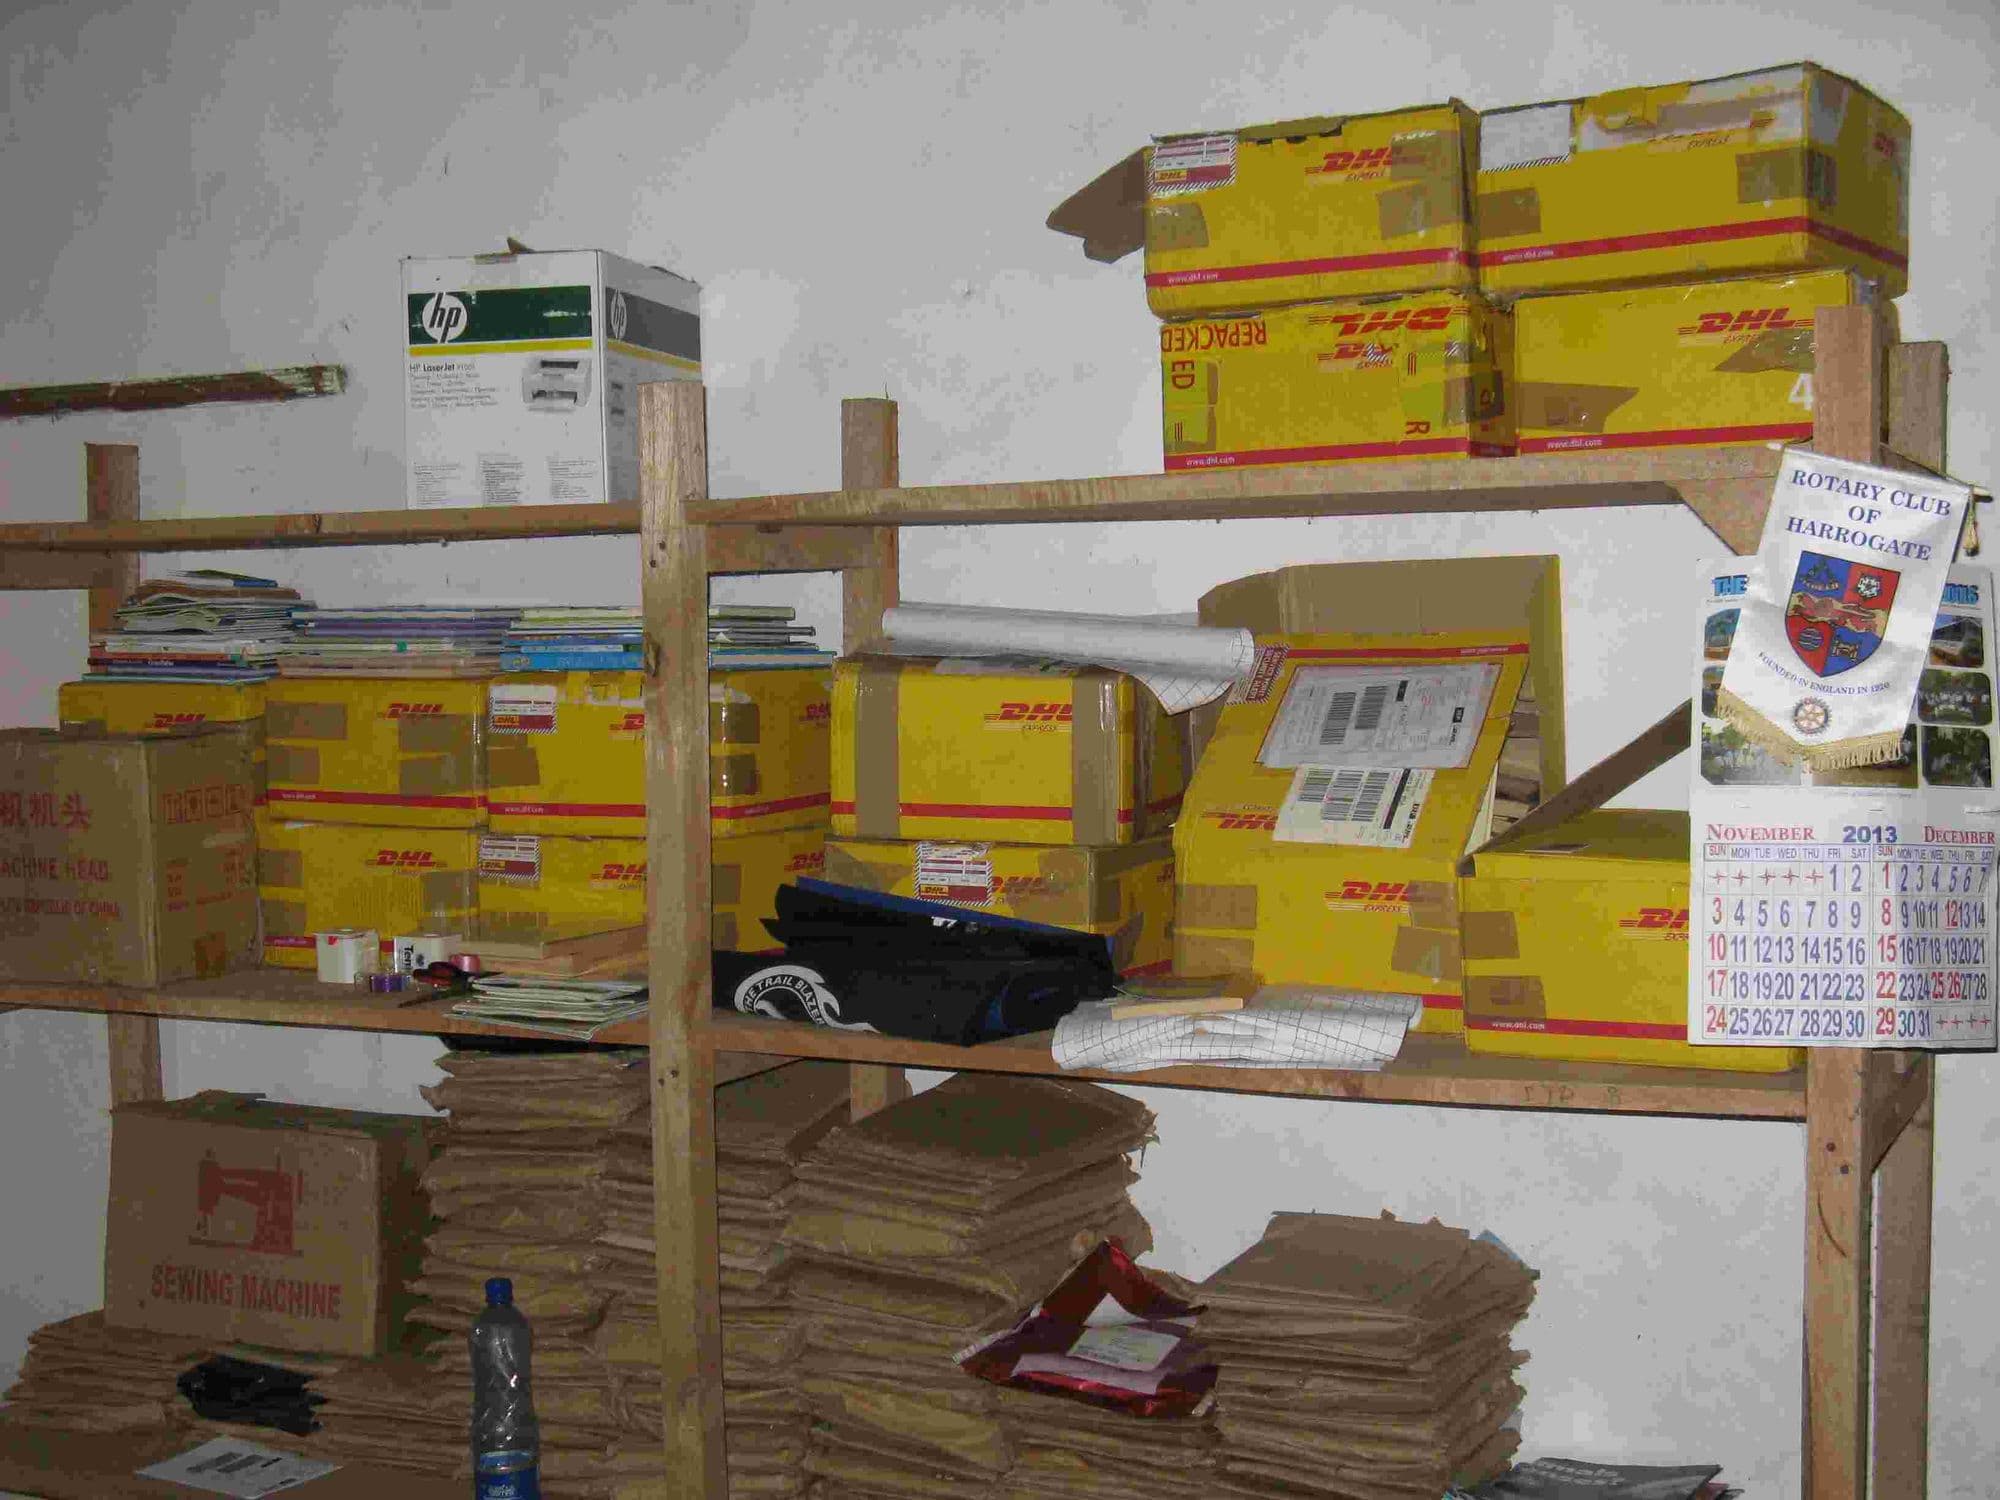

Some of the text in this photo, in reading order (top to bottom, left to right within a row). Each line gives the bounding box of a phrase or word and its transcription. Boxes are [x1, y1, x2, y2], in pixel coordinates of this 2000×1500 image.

[428, 291, 462, 344] hp
[1697, 307, 1790, 333] DHL
[1160, 320, 1267, 352] REPACKED
[1406, 420, 1431, 435] R
[1792, 470, 1950, 516] ROTARY CLUB
[1849, 506, 1881, 524] OF
[1785, 517, 1931, 560] HARROGATE
[1714, 574, 1748, 597] THE
[1758, 651, 1797, 680] FOUNDED
[1810, 682, 1855, 694] ENGLAND
[384, 703, 444, 719] DHL
[1707, 824, 1995, 844] NOVEMBER 2013 DECEMBER
[377, 850, 436, 867] DHL
[1709, 845, 1866, 858] SUN MON TUE WED THU FRI SAT
[1878, 848, 1892, 856] SUN
[601, 863, 647, 881] DH
[1830, 864, 1862, 892] 1 2
[1882, 862, 1987, 893] 1 2 3 4 5 6 7
[1638, 908, 1689, 929] DH
[1712, 898, 1861, 928] 3 4 5 6 7 8 9
[1882, 899, 1985, 928] 8 9 10 11 12 13 14
[1708, 934, 1865, 964] 10 11 12 13 14 15 16
[1878, 935, 1984, 964] 15 16 17 18 19 20 21
[756, 976, 793, 991] TRAIL
[1708, 970, 1864, 1001] 17 18 19 20 21 22 23
[1876, 971, 1987, 1001] 22 23 24 25 26 27 28
[1707, 1006, 1864, 1037] 24 25 26 27 28 29 30
[1876, 1008, 1930, 1038] 29 30 31
[152, 1264, 342, 1321] SEWING MACHINE
